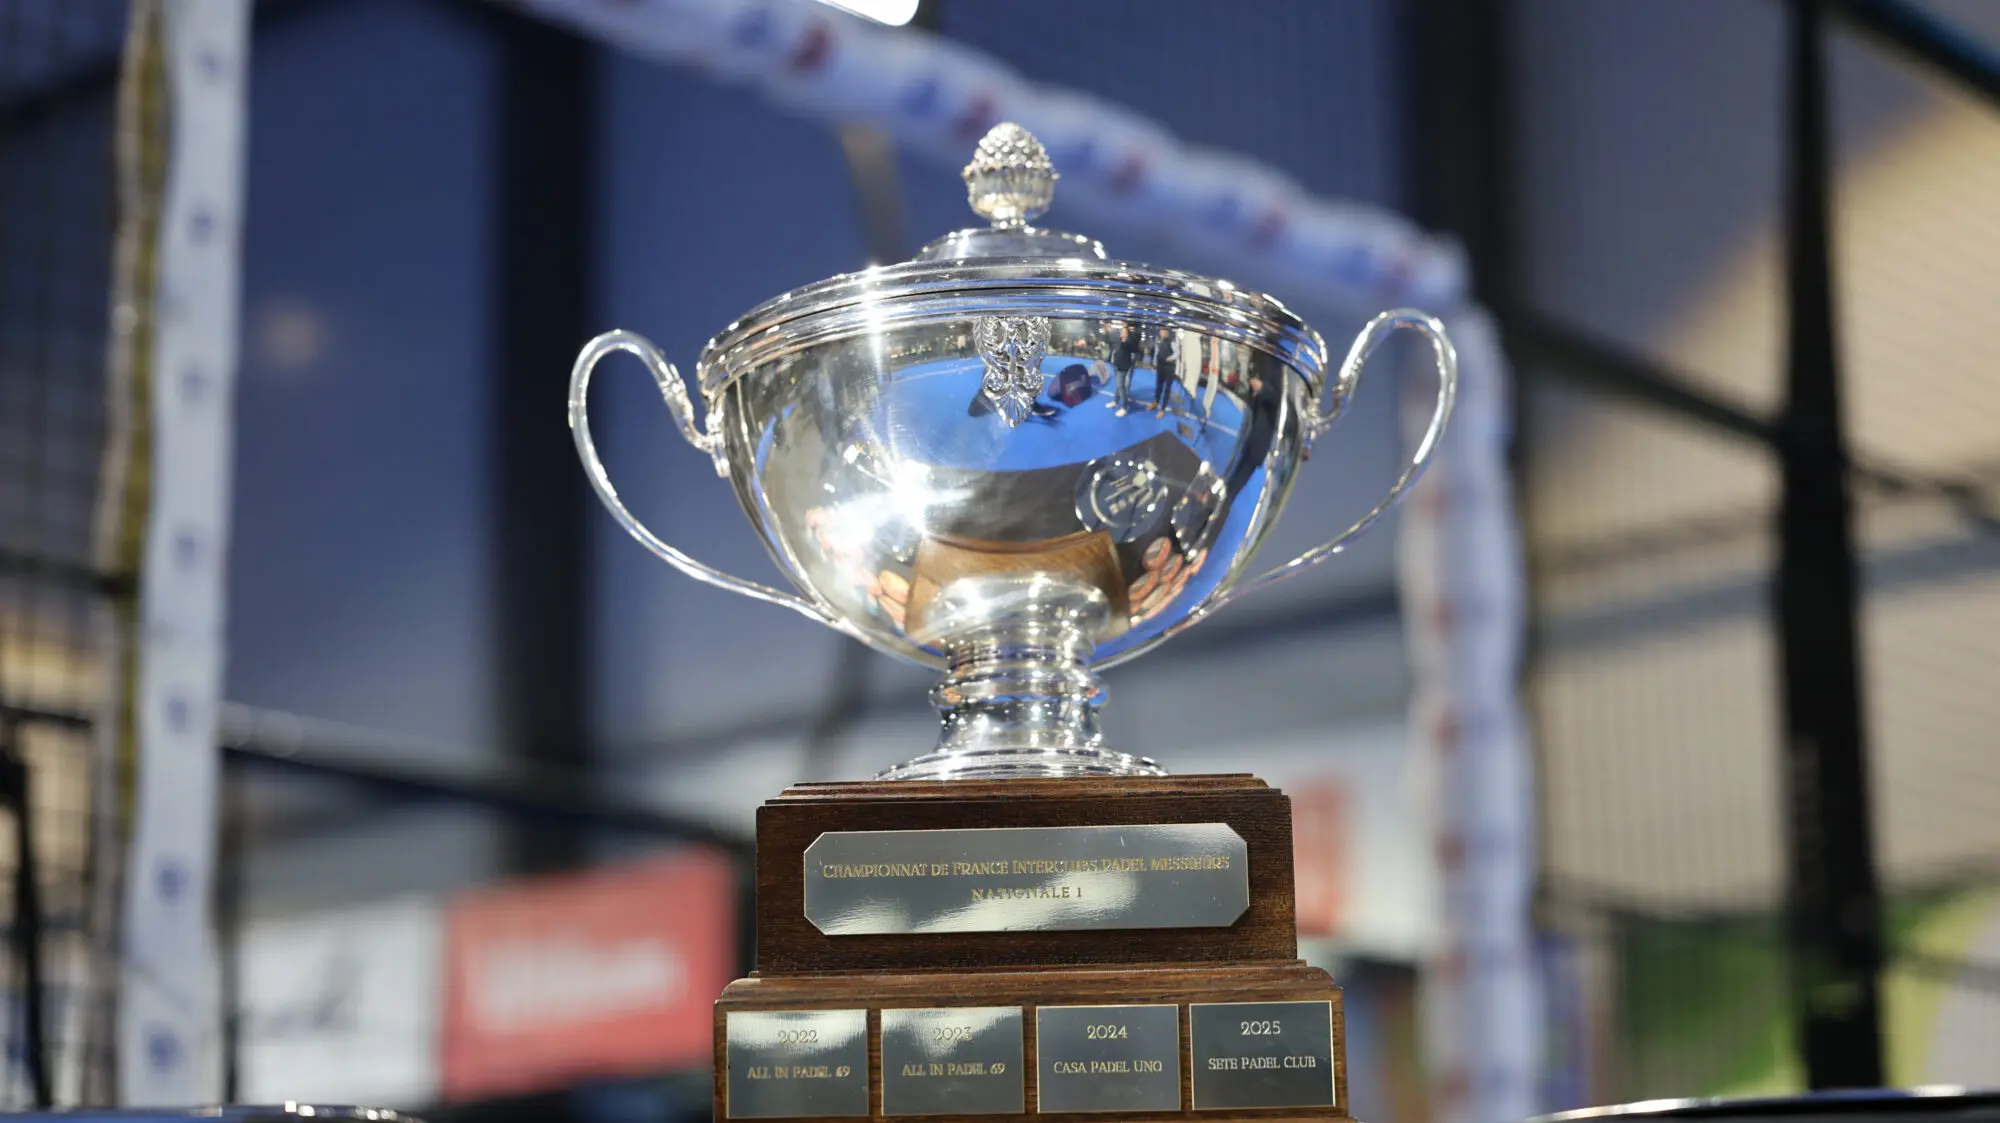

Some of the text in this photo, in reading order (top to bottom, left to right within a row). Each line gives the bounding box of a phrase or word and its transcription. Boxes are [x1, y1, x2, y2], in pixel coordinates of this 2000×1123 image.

[823, 863, 928, 878] CHAMPIONNAT
[931, 863, 949, 876] DE
[953, 861, 1009, 876] FRANCE
[1101, 856, 1147, 872] PADEL
[971, 886, 1070, 900] NATIONALE
[932, 1026, 974, 1041] 2023
[1086, 1024, 1128, 1039] 2024
[1240, 1020, 1281, 1036] 2025
[777, 1029, 818, 1044] 2022
[902, 1062, 1006, 1076] ALL IN PADEL 69
[1054, 1060, 1163, 1074] CASA PADEL UNO
[1208, 1055, 1316, 1070] SETE PADEL CLUB
[747, 1065, 851, 1079] ALL IN PADEL 69
